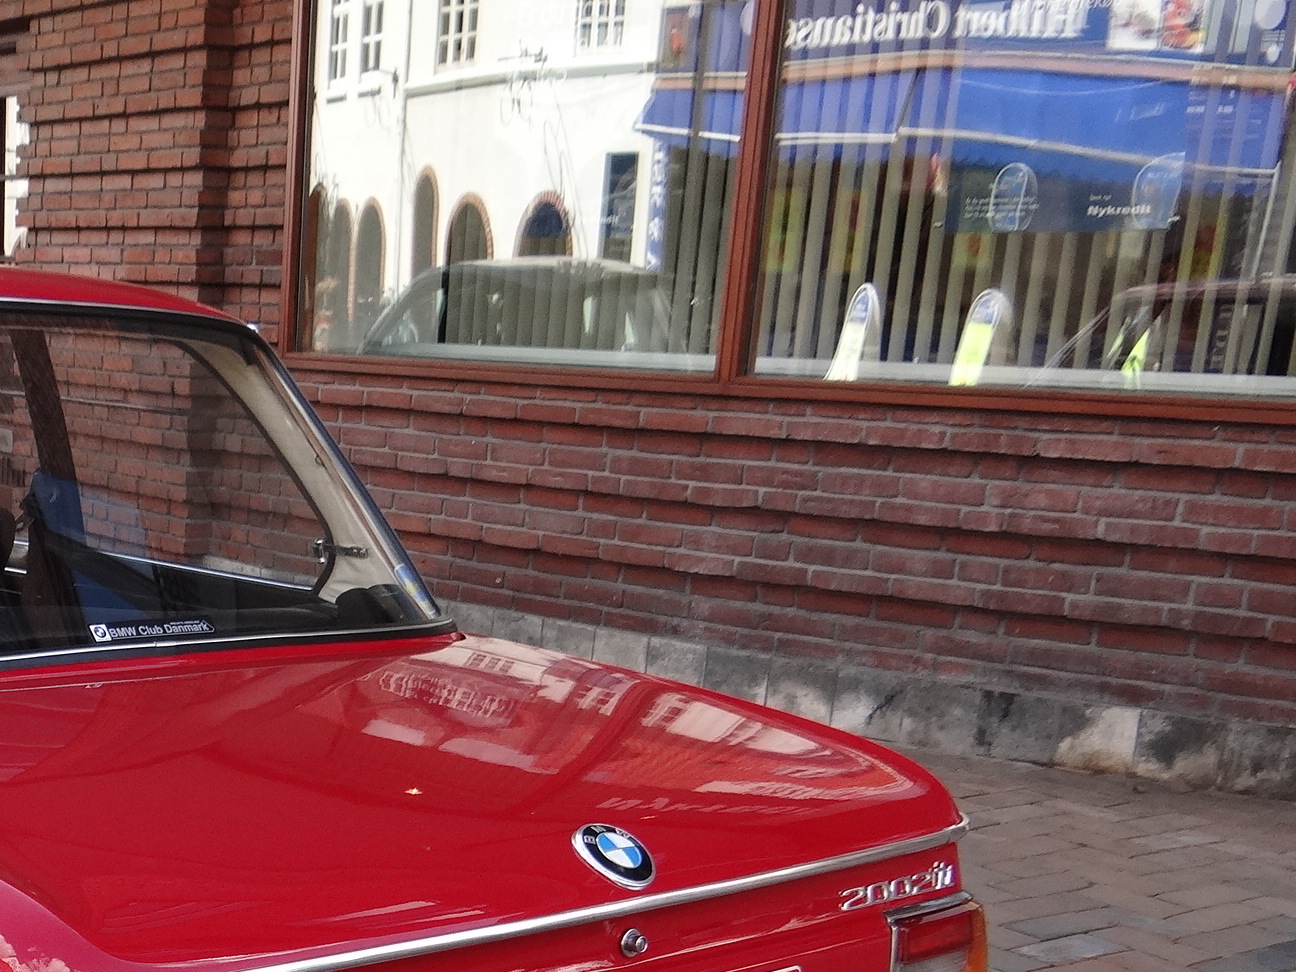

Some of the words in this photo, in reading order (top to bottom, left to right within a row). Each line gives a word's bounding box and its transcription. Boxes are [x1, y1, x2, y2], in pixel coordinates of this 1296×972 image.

[108, 627, 137, 638] BMW
[138, 625, 164, 636] Club
[164, 621, 210, 634] Danmark
